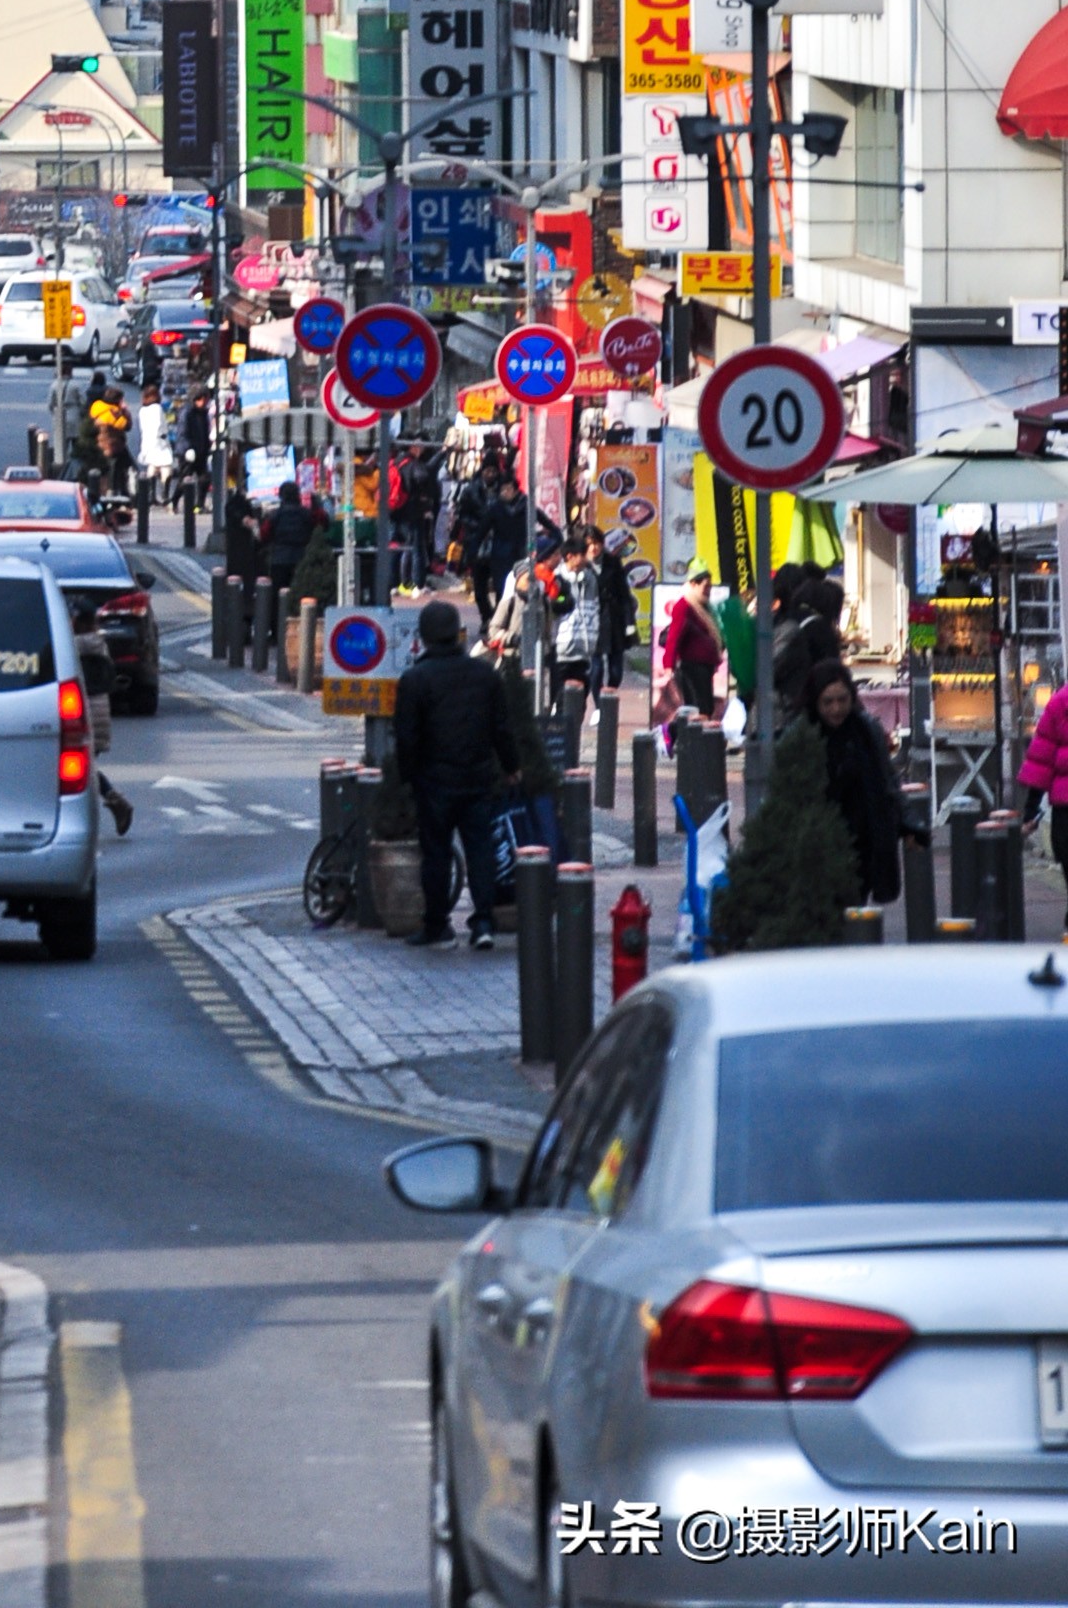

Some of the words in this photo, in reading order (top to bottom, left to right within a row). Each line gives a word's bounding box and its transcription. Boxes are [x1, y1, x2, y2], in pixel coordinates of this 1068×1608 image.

[256, 28, 292, 142] HAIR
[628, 73, 702, 88] 365-3580
[417, 195, 491, 234] 인쇄
[741, 387, 803, 449] 20
